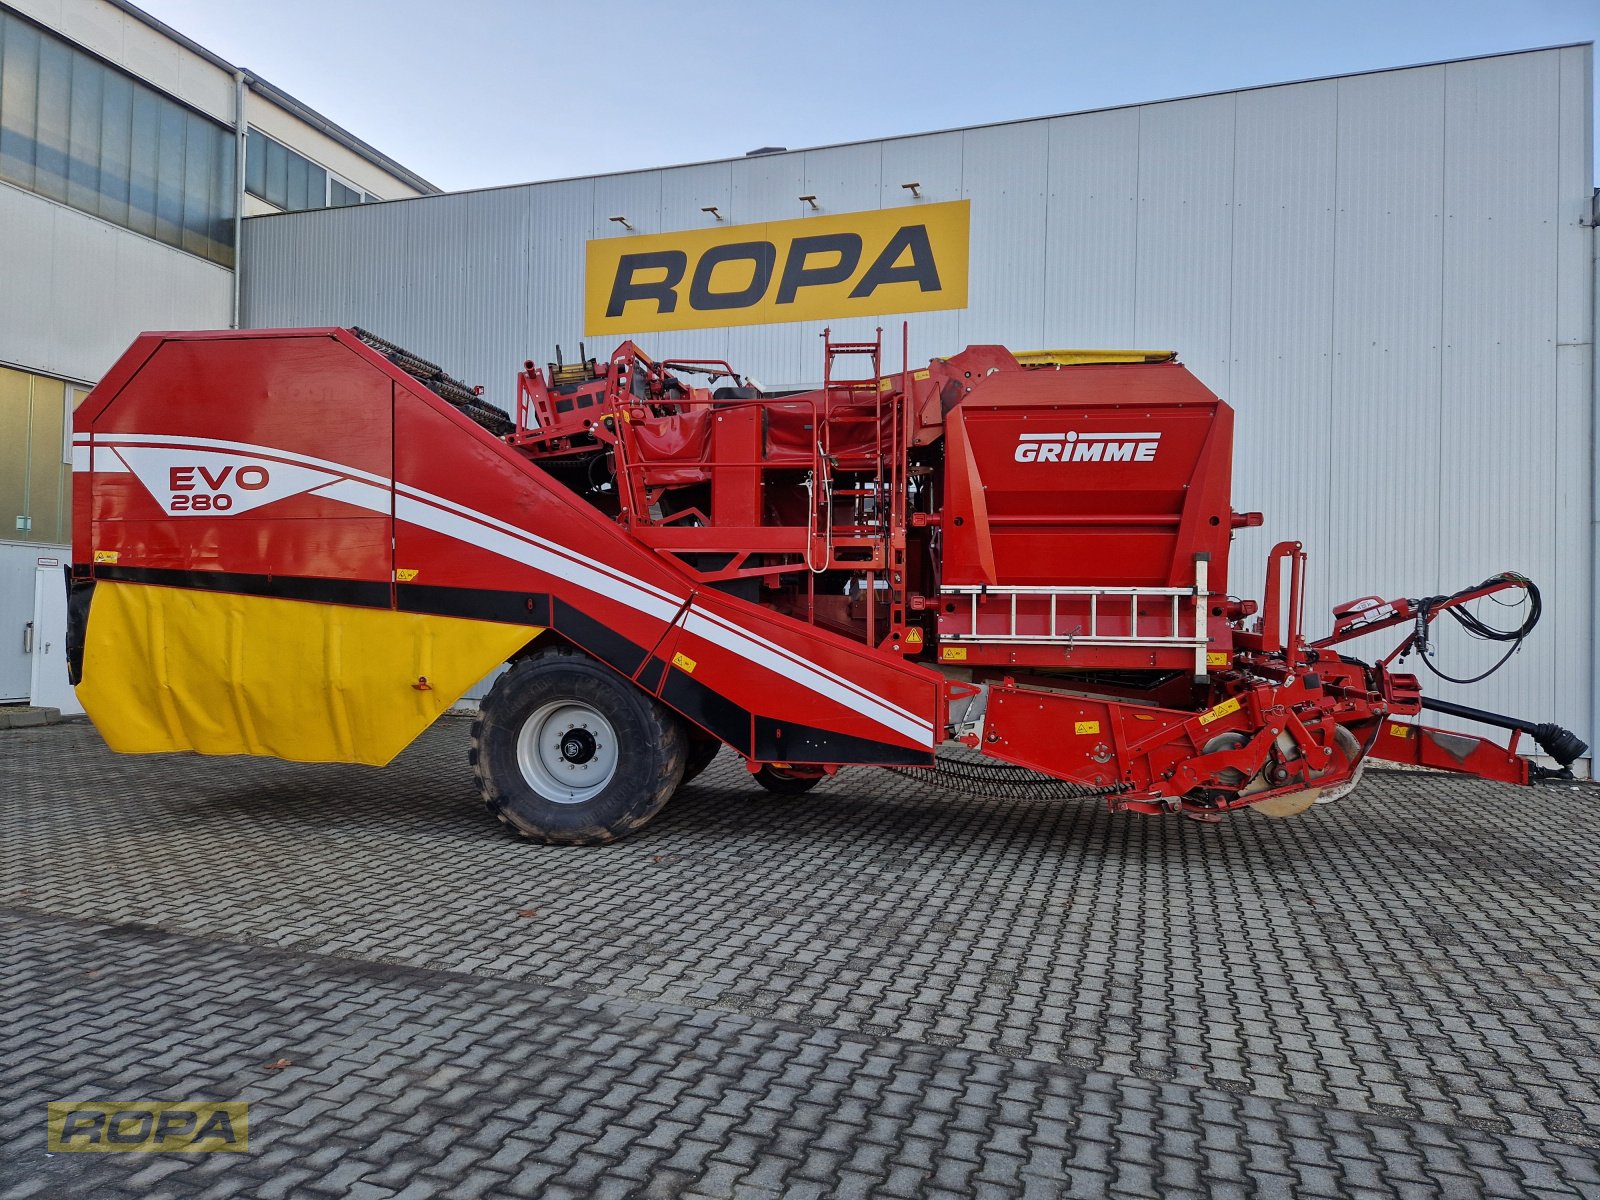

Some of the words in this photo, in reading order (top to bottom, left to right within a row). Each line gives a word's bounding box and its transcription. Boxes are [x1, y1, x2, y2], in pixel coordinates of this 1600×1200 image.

[605, 223, 942, 318] ROPA
[169, 465, 270, 491] EVO
[170, 493, 233, 511] 280
